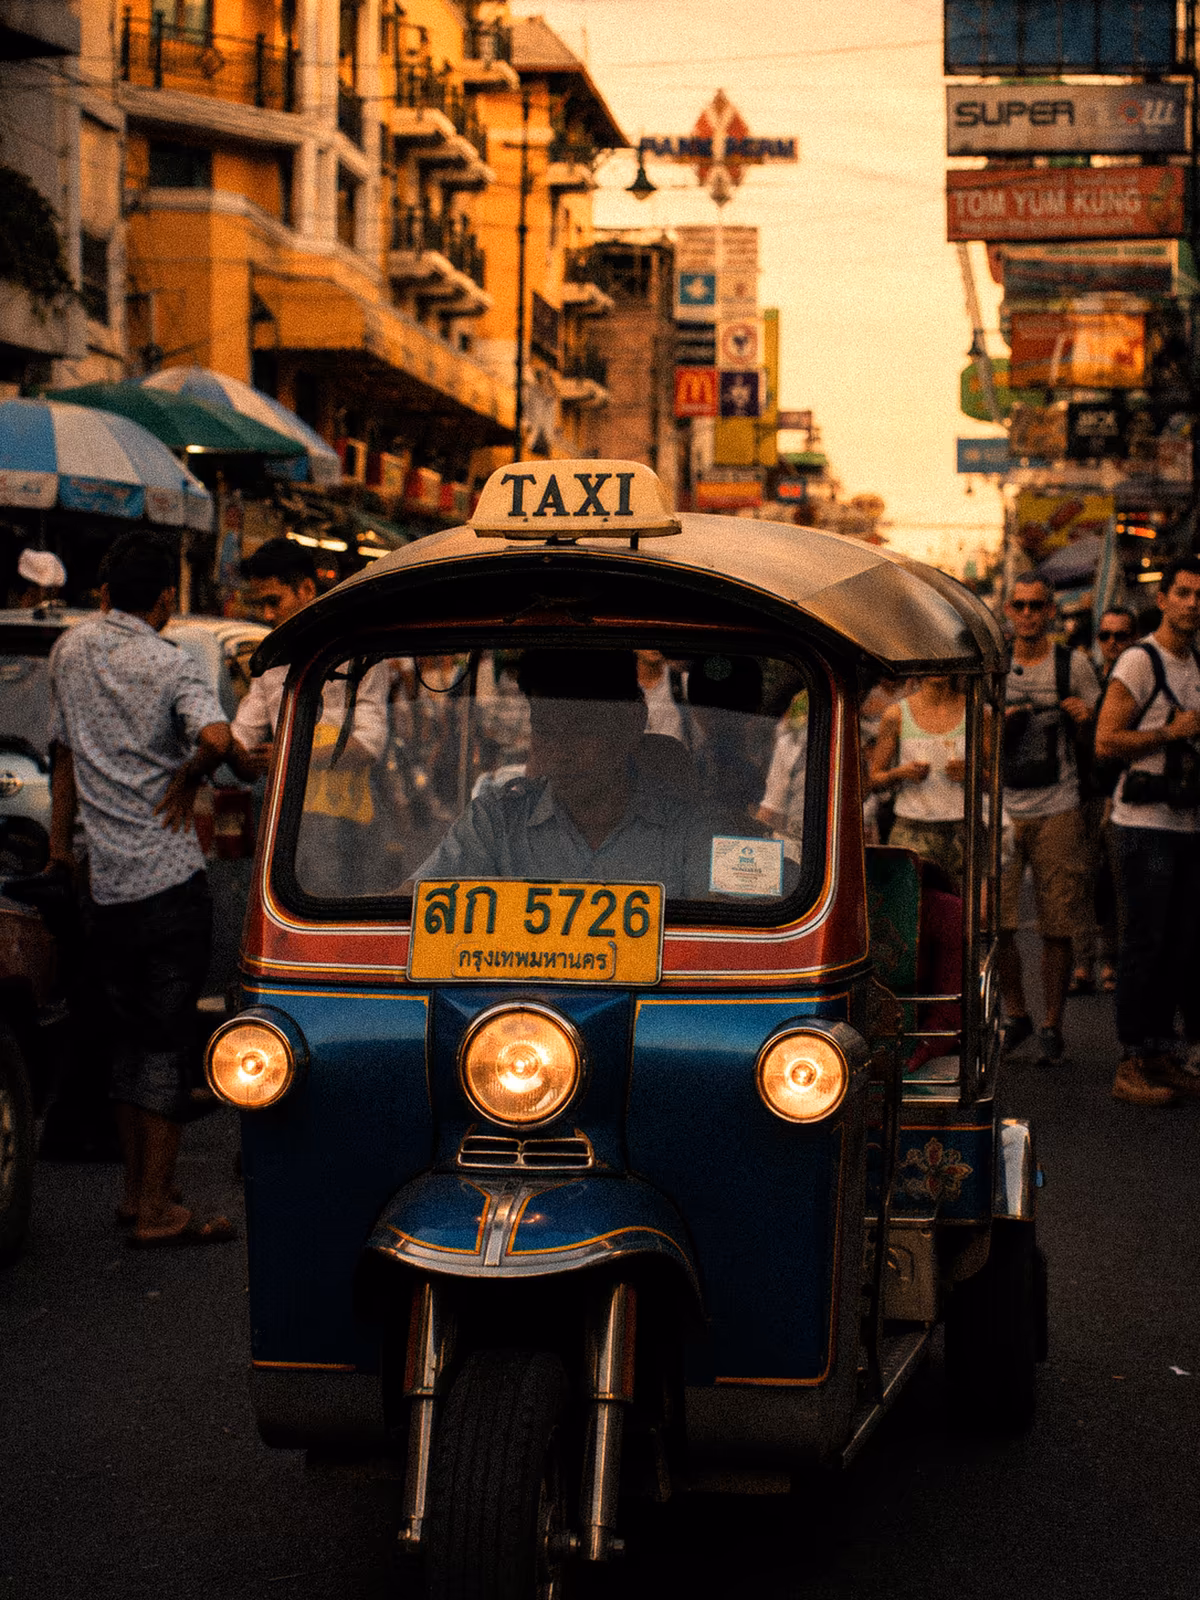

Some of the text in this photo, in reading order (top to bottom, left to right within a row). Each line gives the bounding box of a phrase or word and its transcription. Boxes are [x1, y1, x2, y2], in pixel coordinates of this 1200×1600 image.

[955, 100, 1075, 128] SUPER
[955, 187, 1142, 217] TOM YUM KUNG
[501, 473, 635, 517] TAXI
[424, 883, 651, 938] สก 5726
[458, 949, 608, 972] กรุงเทพมหานคร
